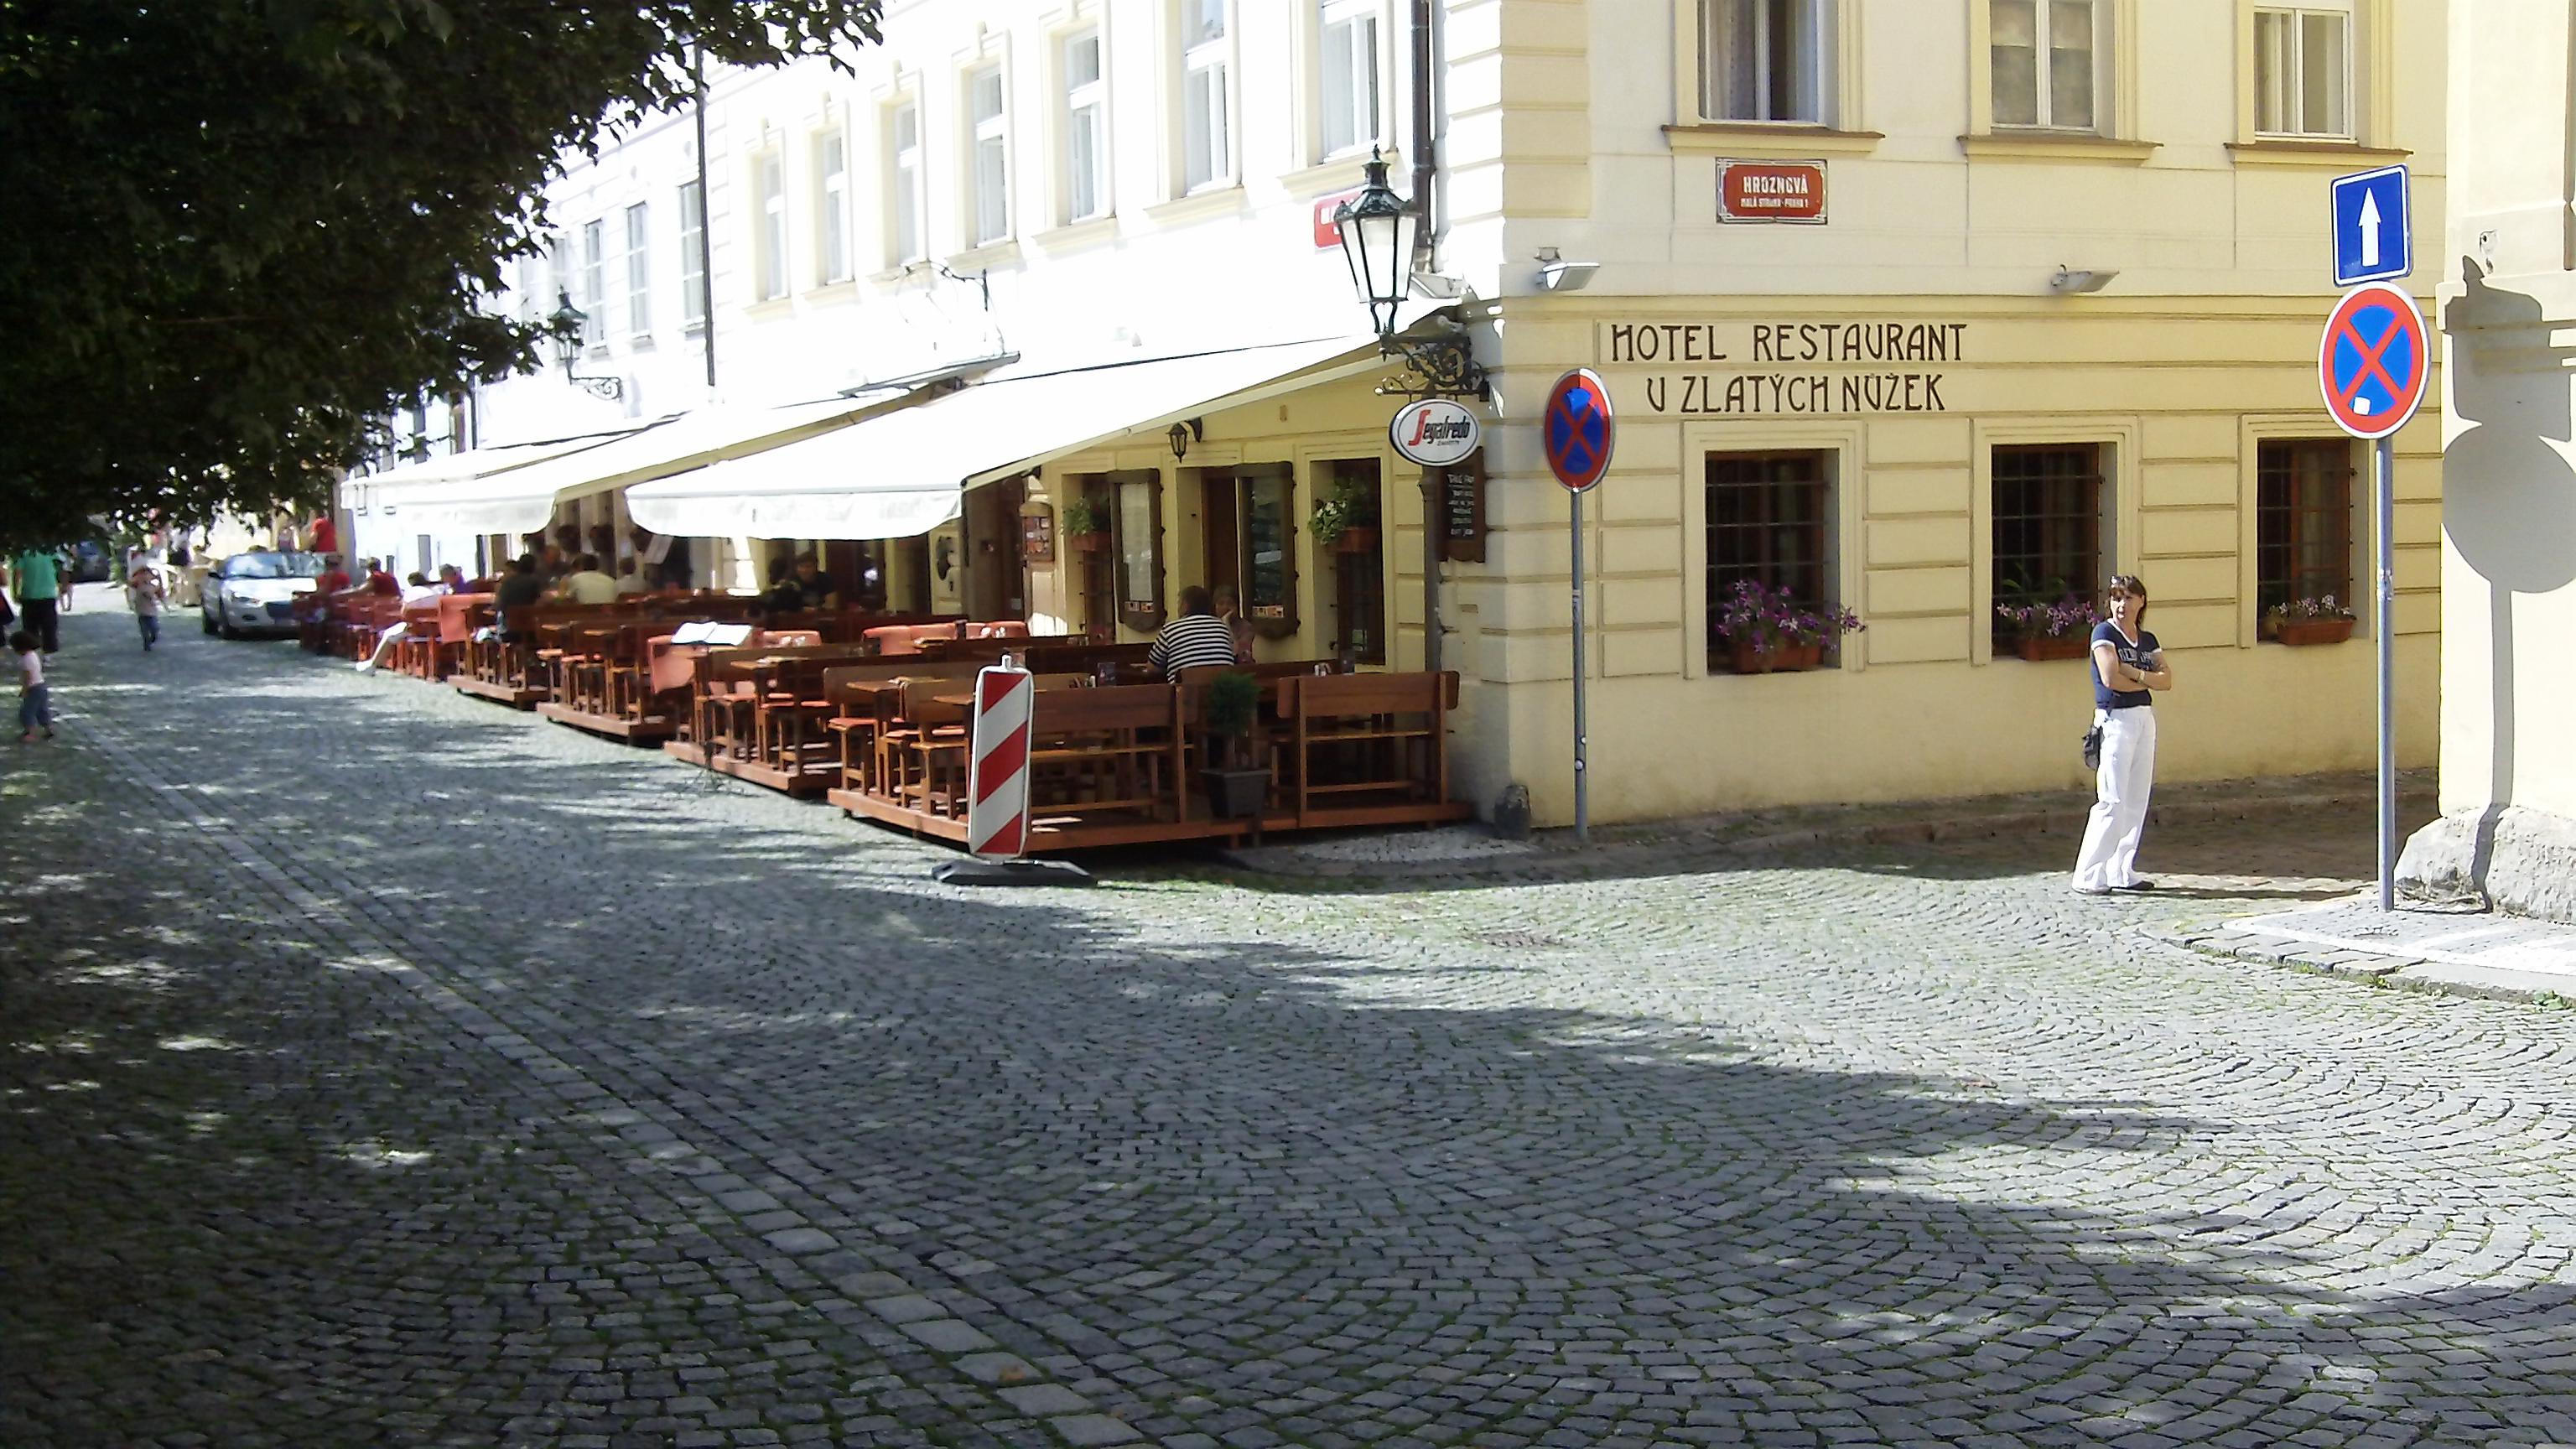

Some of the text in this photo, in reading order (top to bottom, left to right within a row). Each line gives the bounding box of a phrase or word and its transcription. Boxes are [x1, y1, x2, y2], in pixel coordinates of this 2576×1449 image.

[1743, 174, 1809, 195] HROZNOVÁ
[1611, 323, 1967, 361] HOTEL RESTAURANT
[1647, 377, 1665, 412] U
[1680, 373, 1830, 413] ZLATÝCH
[1408, 409, 1471, 446] Segafredo
